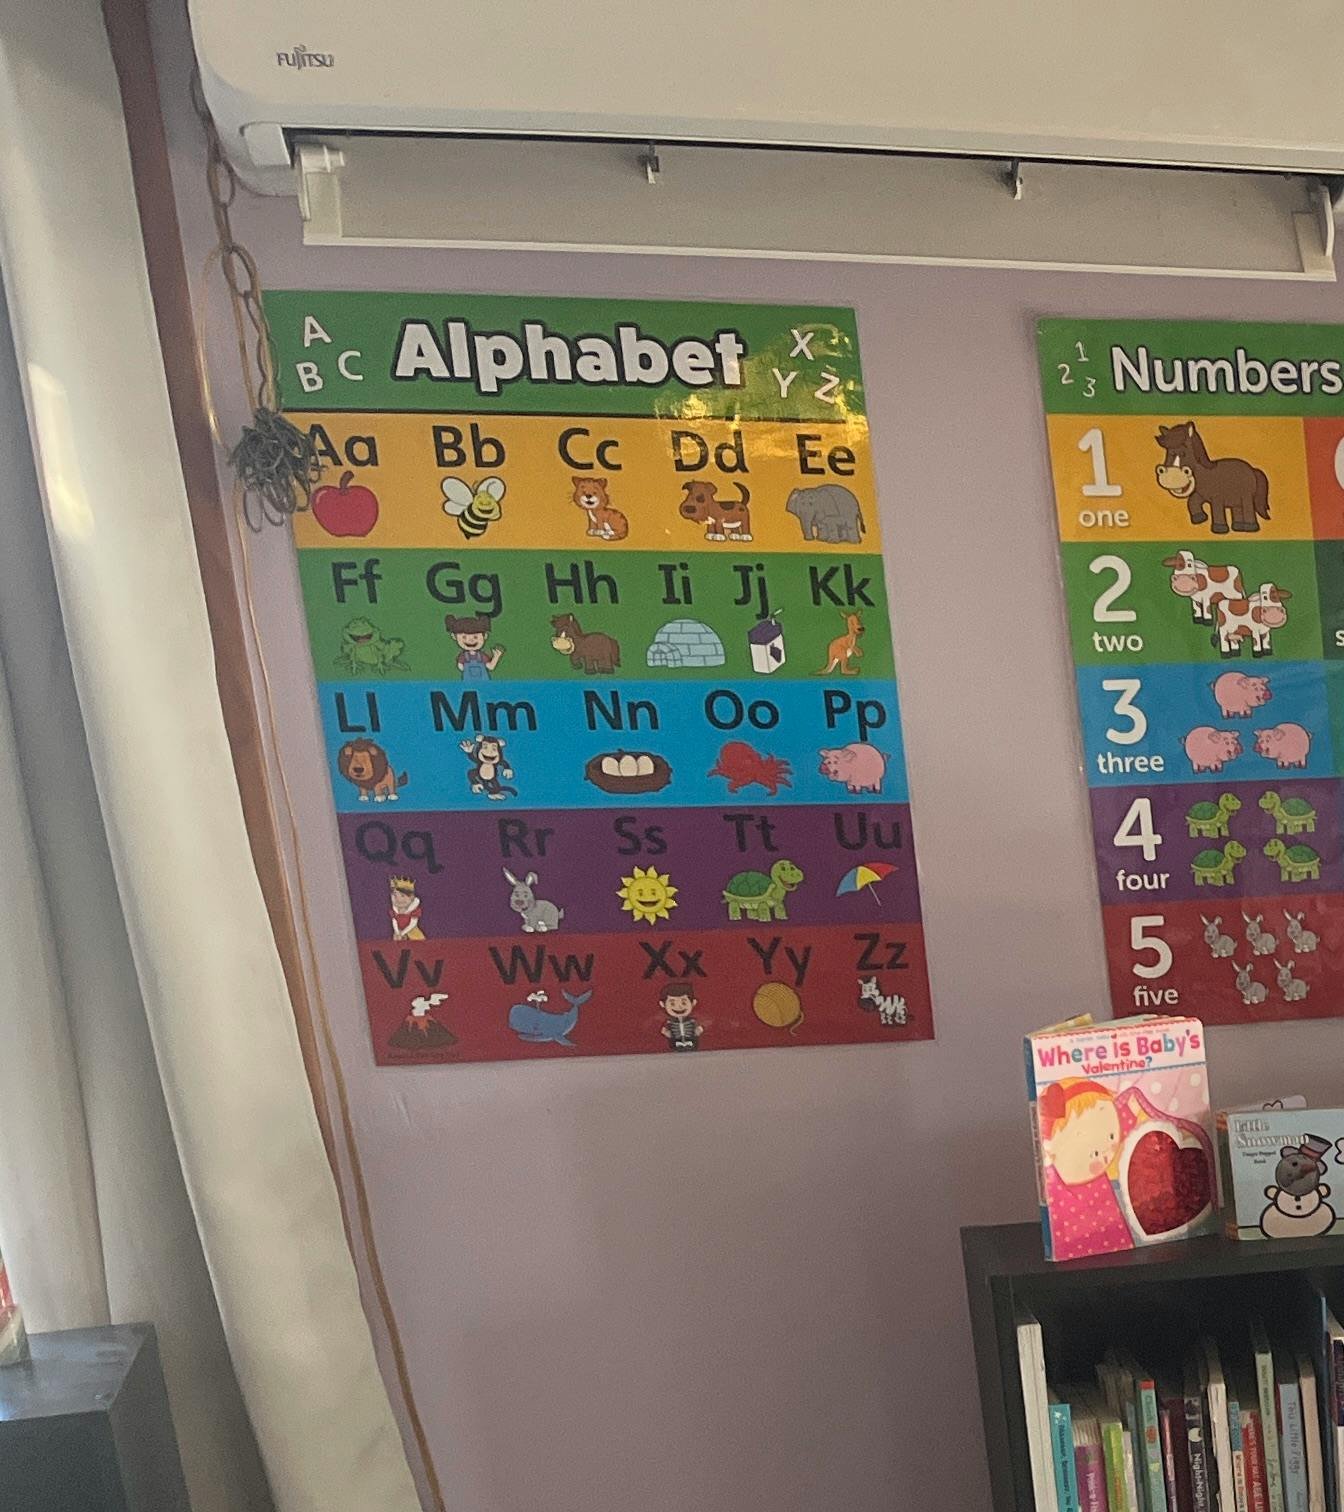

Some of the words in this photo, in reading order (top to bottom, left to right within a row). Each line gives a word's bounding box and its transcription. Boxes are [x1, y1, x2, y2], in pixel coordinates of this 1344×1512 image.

[276, 45, 334, 70] FUJITSU
[303, 315, 331, 347] A
[789, 328, 815, 360] X
[337, 351, 363, 381] C
[394, 320, 745, 394] Alphabet
[1075, 342, 1089, 363] 1
[297, 362, 322, 392] B
[772, 367, 797, 398] Y
[1057, 363, 1074, 385] 2
[1110, 345, 1344, 396] Numbers
[815, 375, 840, 404] Z
[1083, 377, 1096, 398] 3
[308, 425, 378, 467] Aa
[433, 426, 505, 468] Bb
[559, 428, 622, 472] Cc
[674, 430, 749, 474] Dd
[800, 434, 856, 476] Ee
[1078, 428, 1122, 497] 1
[1079, 507, 1129, 529] one
[332, 561, 381, 604] Ff
[427, 561, 502, 618] Gg
[546, 561, 618, 605] Hh
[661, 563, 692, 605] Ii
[733, 563, 769, 620] Jj
[810, 566, 874, 608] Kk
[1089, 555, 1137, 623] 2
[1093, 631, 1143, 653] two
[335, 691, 381, 733] Ll
[431, 690, 536, 731] Mm
[584, 690, 659, 730] Nn
[704, 689, 780, 730] Oo
[823, 689, 886, 741] Pp
[1102, 678, 1148, 744] 3
[1096, 751, 1165, 774] three
[356, 821, 443, 874] Qq
[498, 820, 555, 858] Rr
[613, 817, 667, 855] Ss
[724, 814, 779, 853] Tt
[834, 814, 901, 849] Uu
[1113, 797, 1162, 861] 4
[1115, 868, 1170, 891] four
[372, 949, 443, 988] Vv
[489, 945, 594, 985] Ww
[640, 941, 707, 979] Xx
[747, 937, 812, 985] Yy
[855, 934, 908, 970] Zz
[1130, 915, 1174, 979] 5
[1133, 985, 1180, 1007] five
[1037, 1045, 1108, 1068] Where
[1113, 1038, 1131, 1058] is
[1136, 1029, 1201, 1057] Baby's
[1081, 1056, 1153, 1075] Valentine?
[1252, 1480, 1264, 1499] ABE
